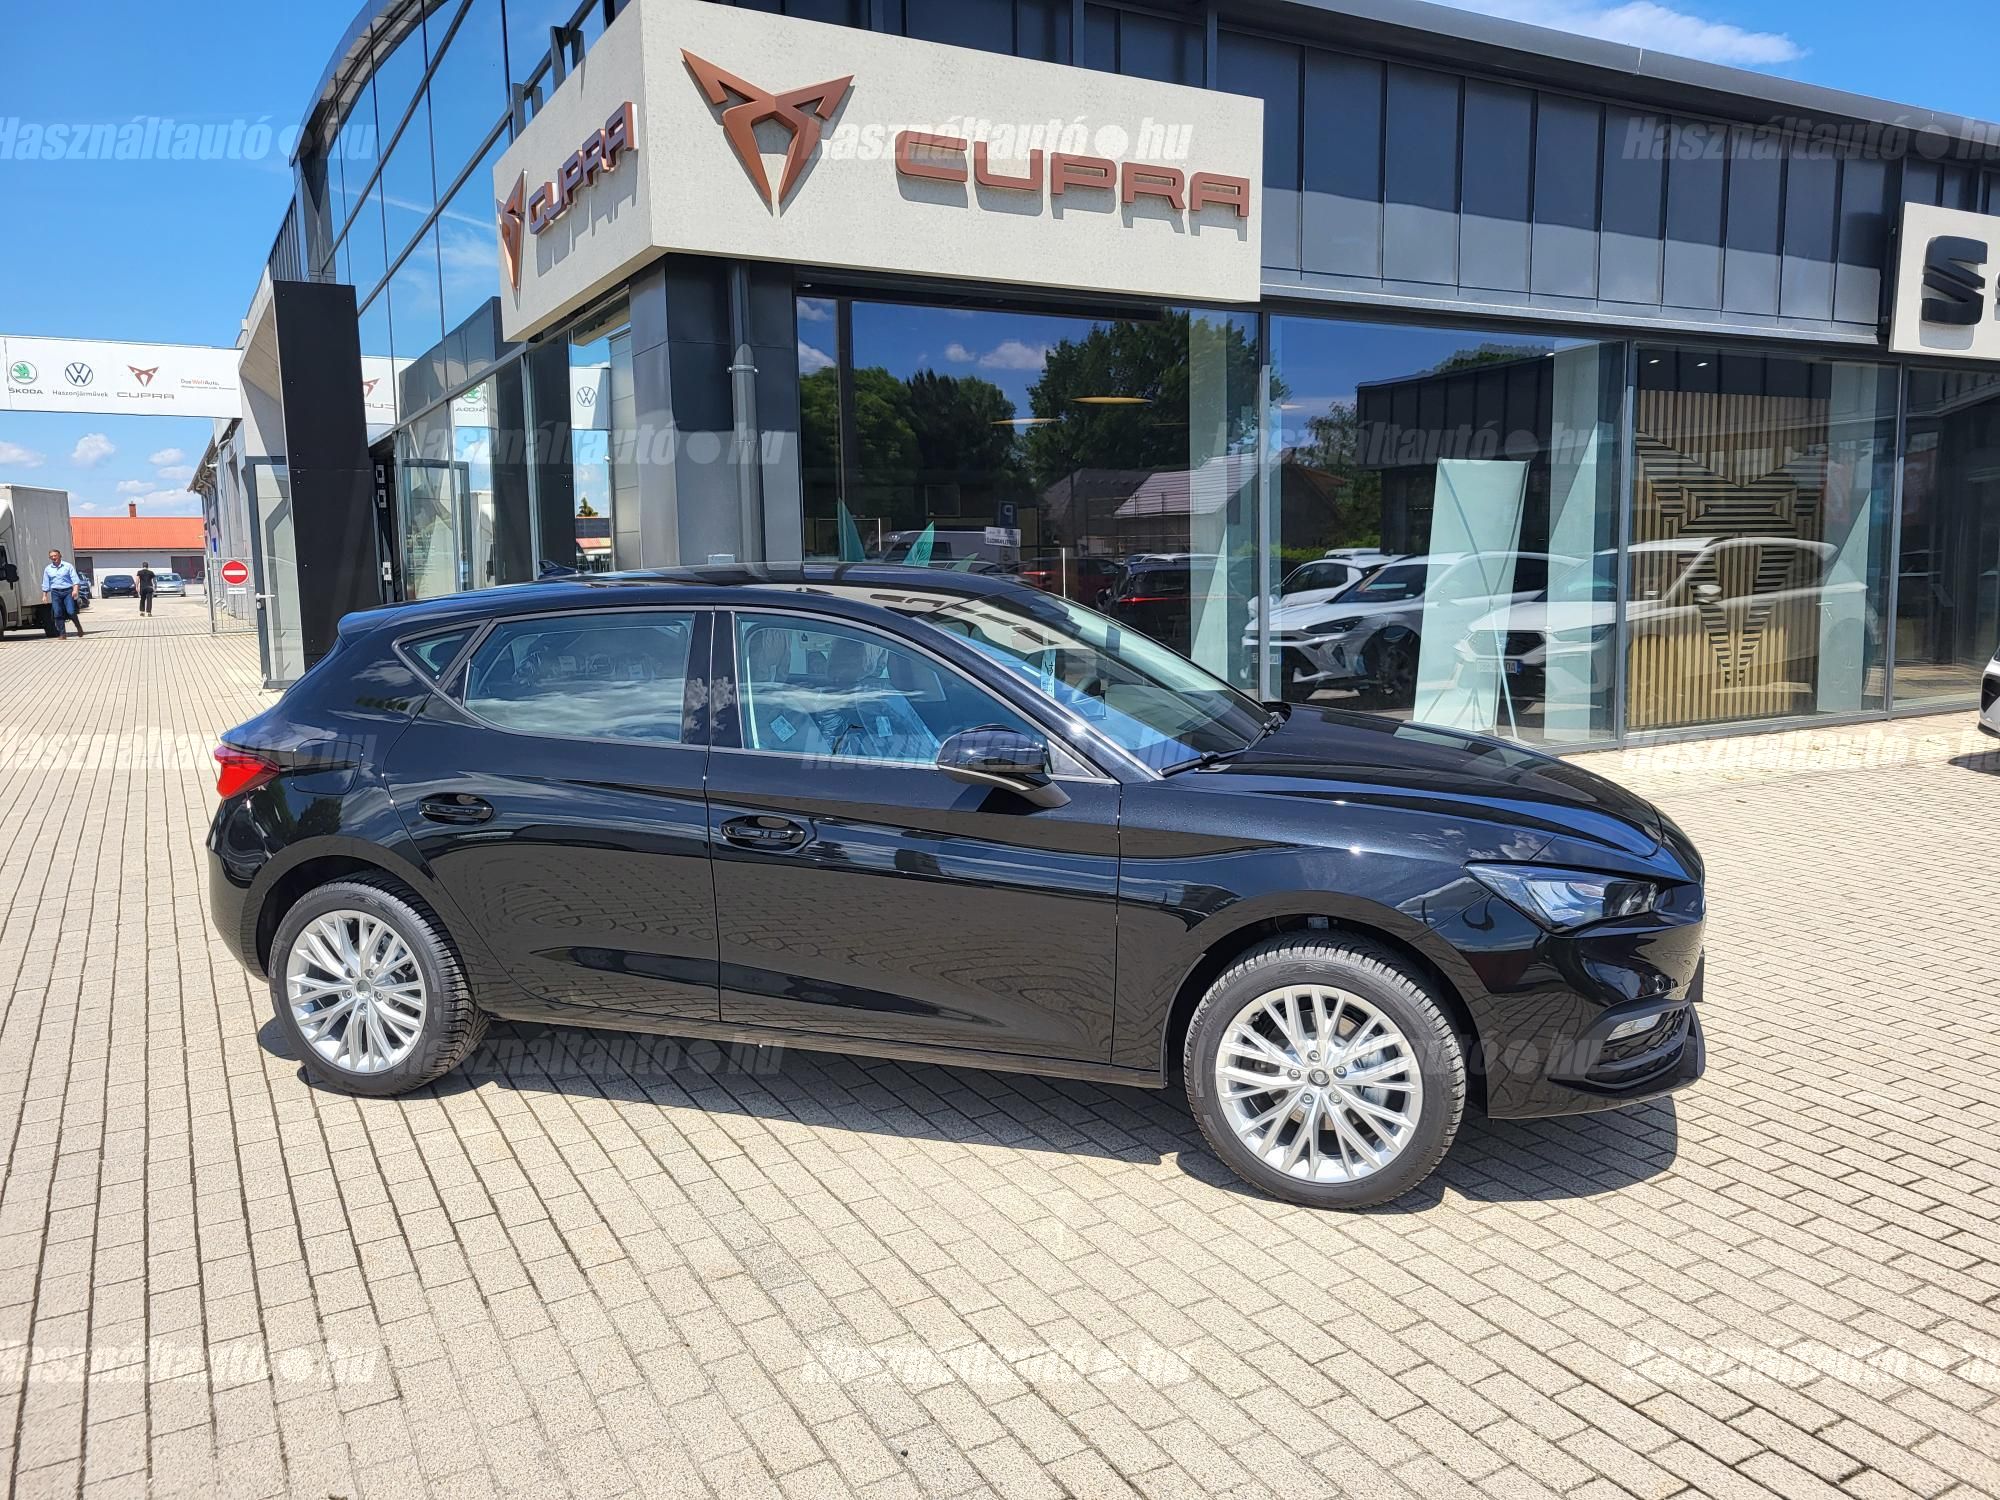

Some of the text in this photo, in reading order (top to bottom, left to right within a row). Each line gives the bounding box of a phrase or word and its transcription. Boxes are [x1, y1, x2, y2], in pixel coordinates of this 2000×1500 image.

[528, 101, 635, 235] CUPRA
[895, 129, 1250, 218] CUPRA
[116, 391, 175, 400] CUPRA
